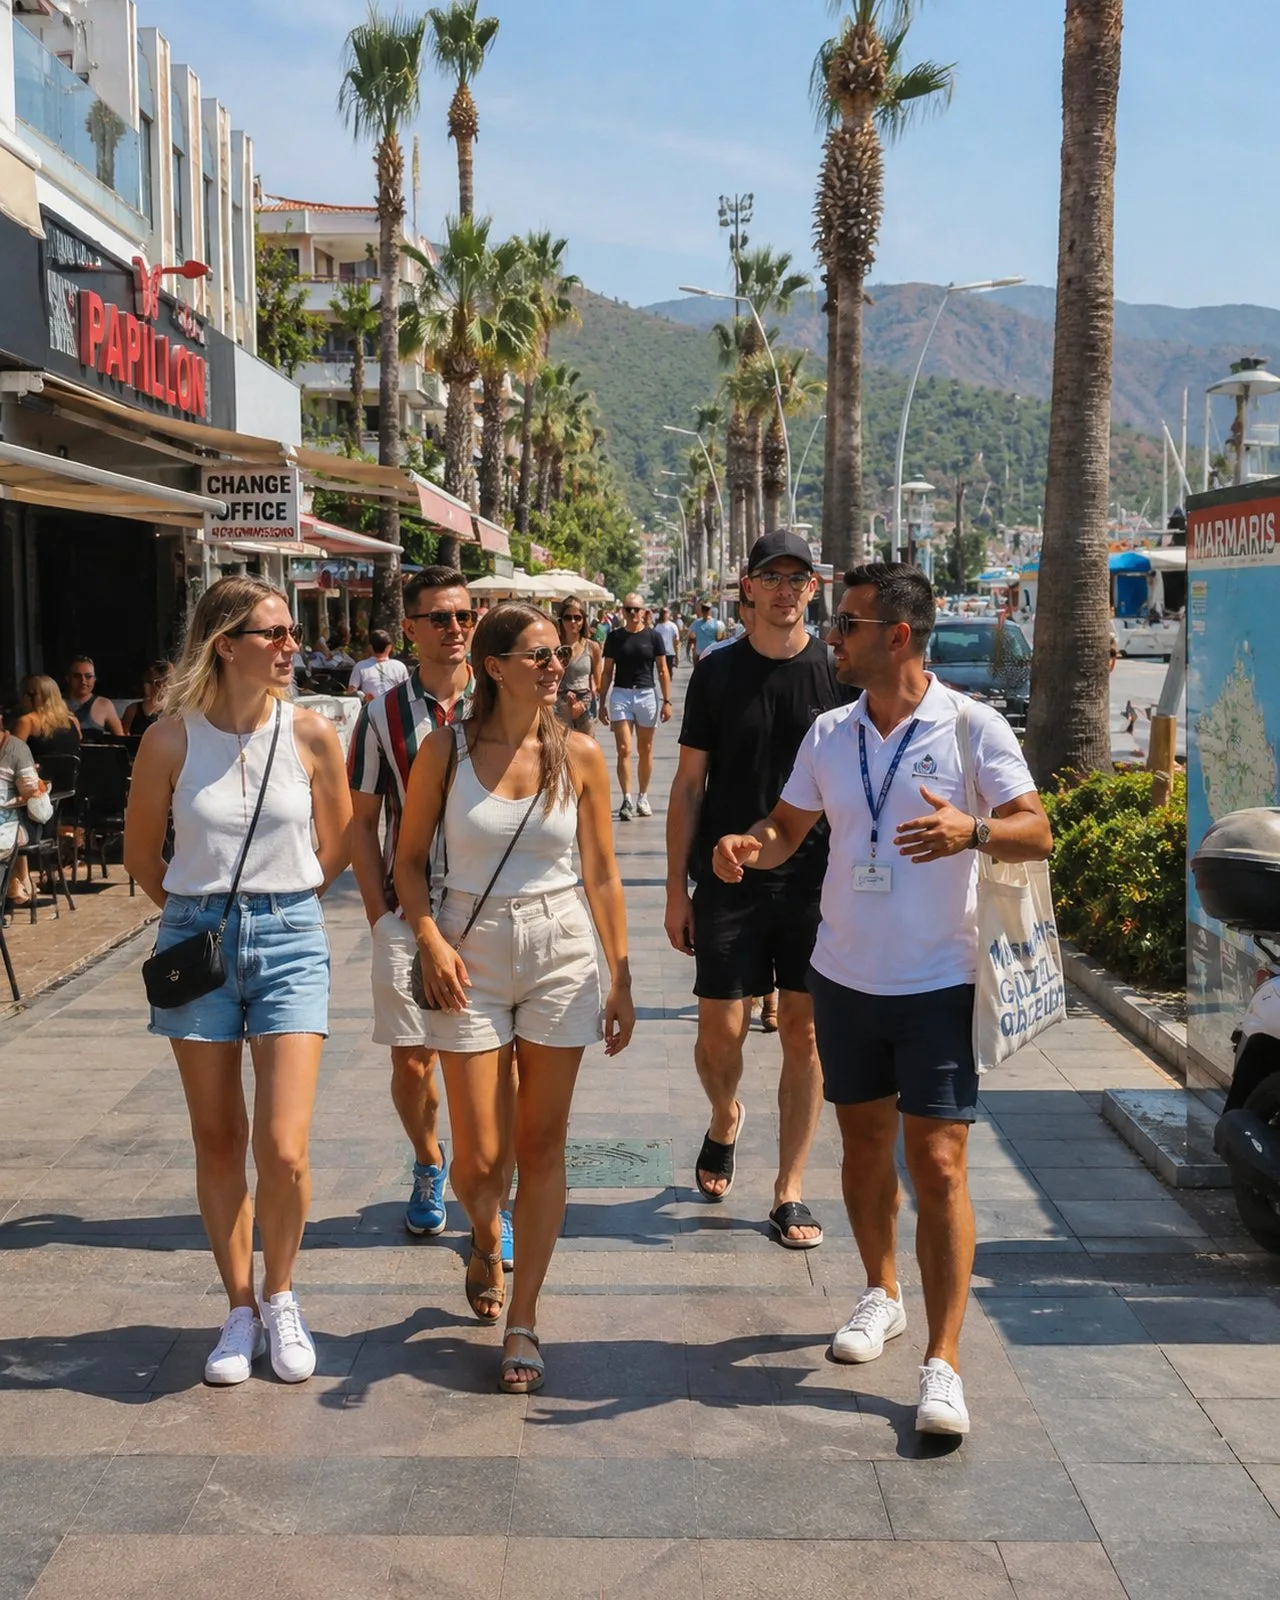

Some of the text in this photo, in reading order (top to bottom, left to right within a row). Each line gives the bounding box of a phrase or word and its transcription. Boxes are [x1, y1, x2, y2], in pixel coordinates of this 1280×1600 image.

[77, 289, 205, 418] PAPILLON
[207, 475, 291, 494] CHANGE
[1194, 512, 1275, 560] MARMARIS
